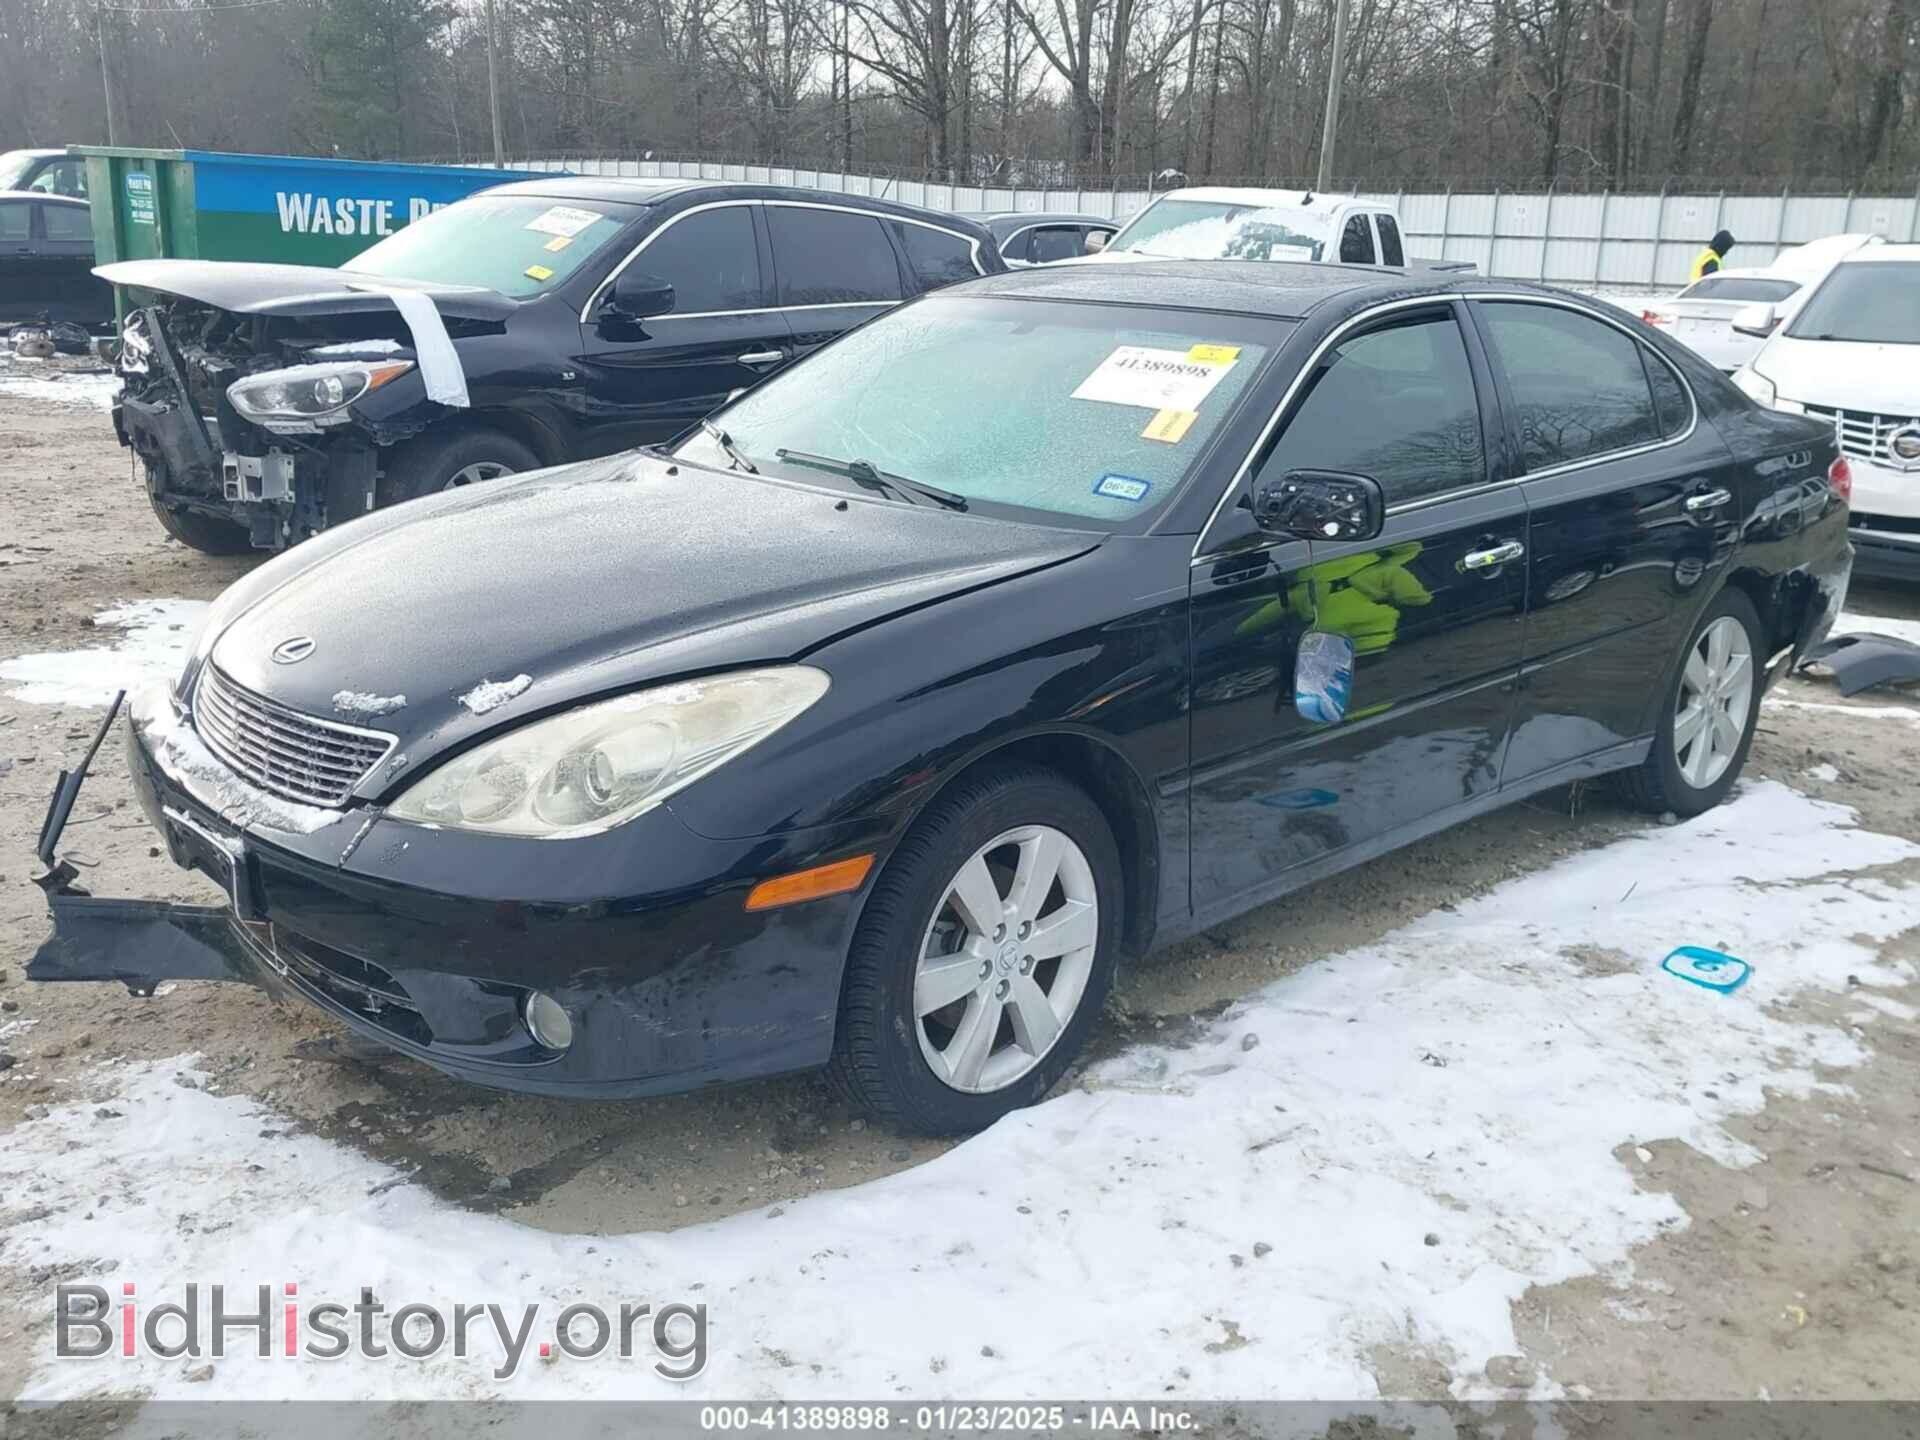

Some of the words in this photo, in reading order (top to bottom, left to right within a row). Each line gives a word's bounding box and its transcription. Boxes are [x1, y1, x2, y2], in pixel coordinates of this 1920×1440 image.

[276, 192, 393, 235] WASTE
[409, 198, 449, 225] P
[1114, 358, 1212, 377] 41389898
